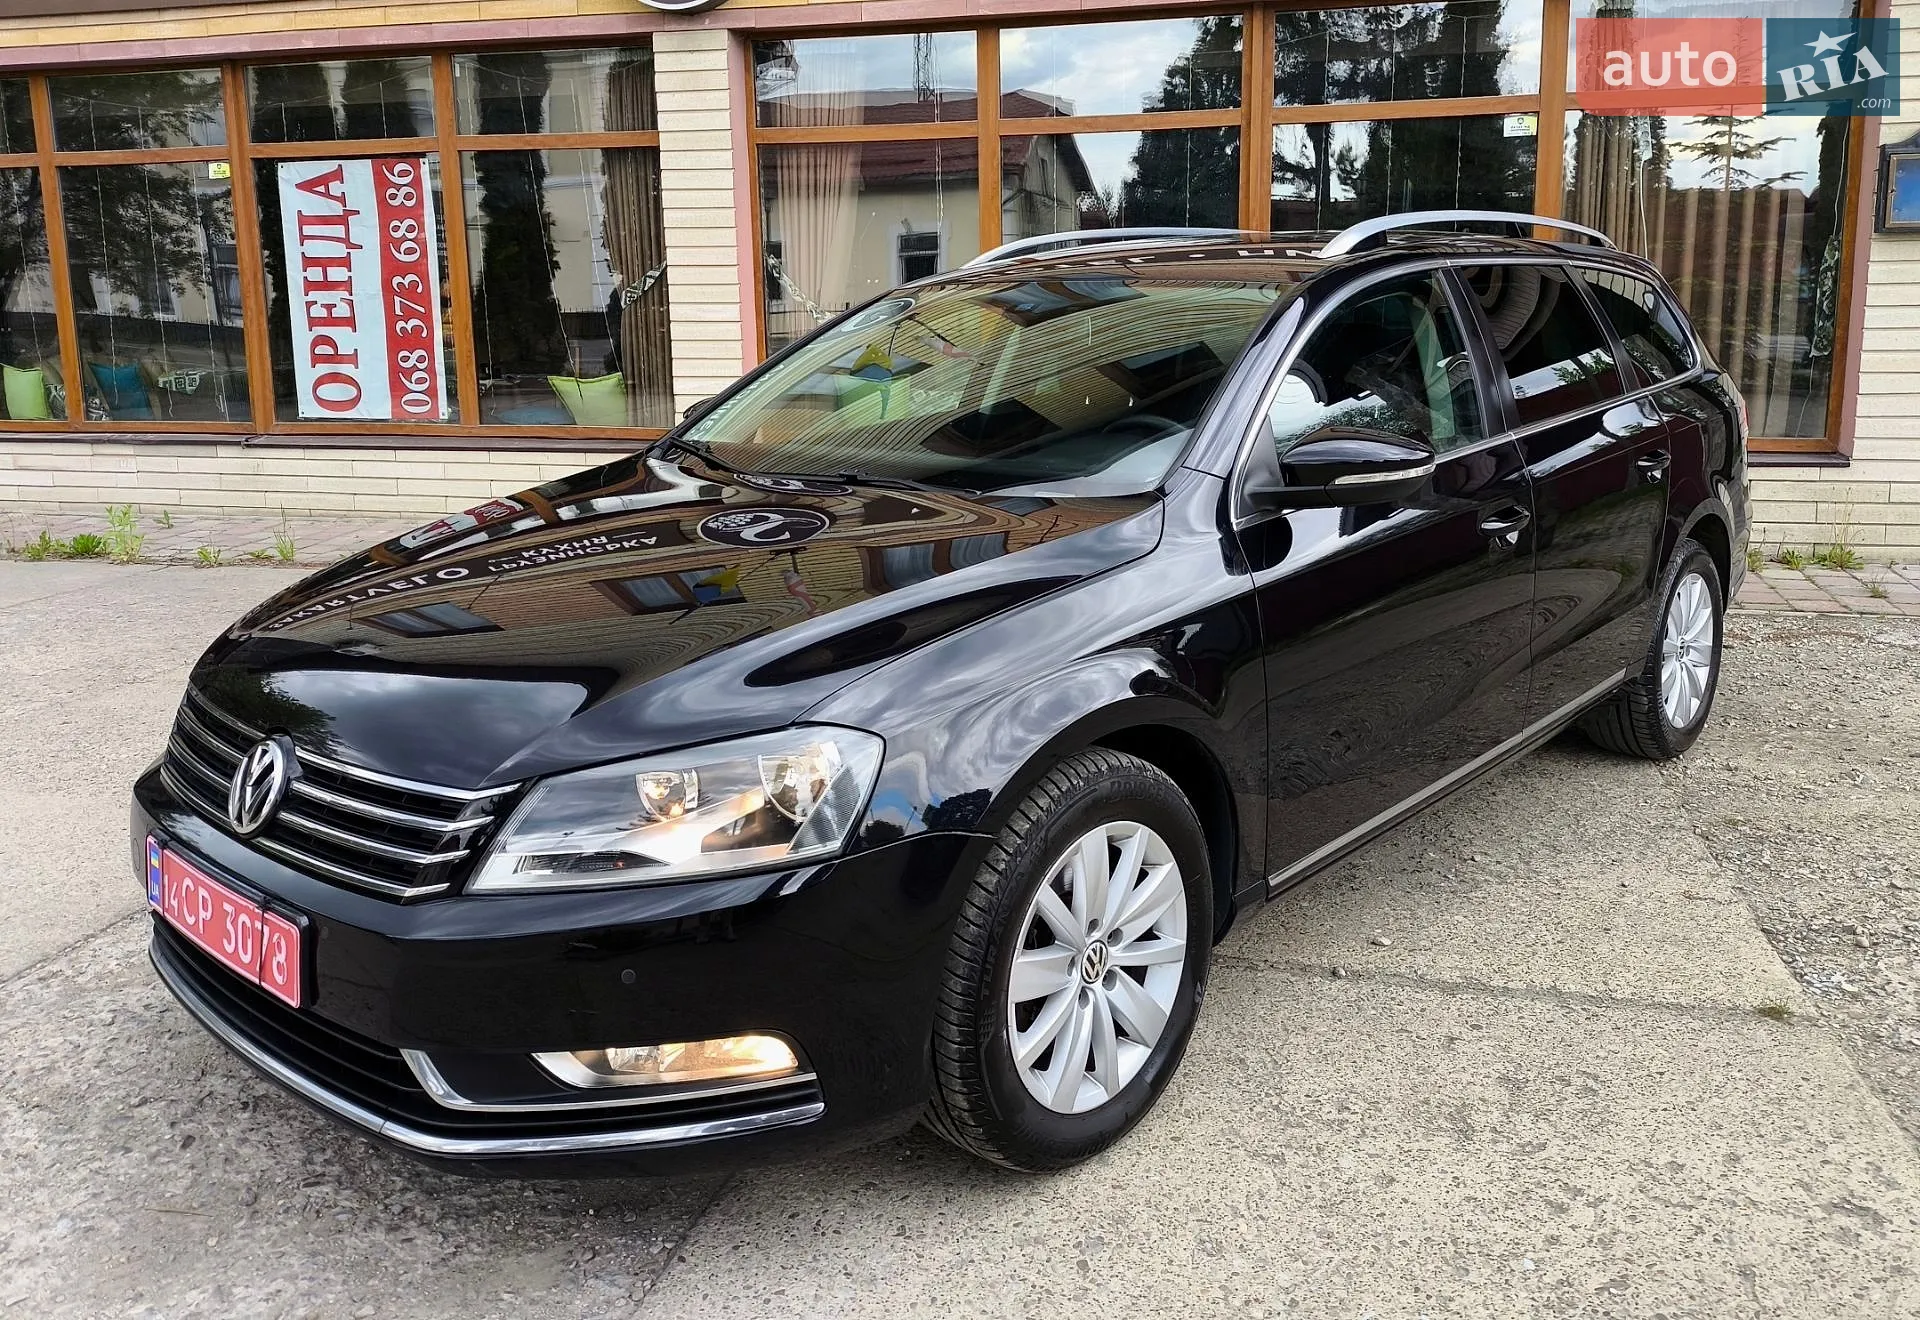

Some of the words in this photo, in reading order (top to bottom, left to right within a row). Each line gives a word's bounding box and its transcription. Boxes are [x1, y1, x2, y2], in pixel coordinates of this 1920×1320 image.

[382, 162, 417, 207] 86
[389, 218, 421, 263] 68
[295, 164, 363, 412] ОРЕНДА
[392, 272, 428, 338] 373
[397, 349, 432, 414] 068
[151, 880, 160, 899] UA
[222, 903, 287, 986] 3078
